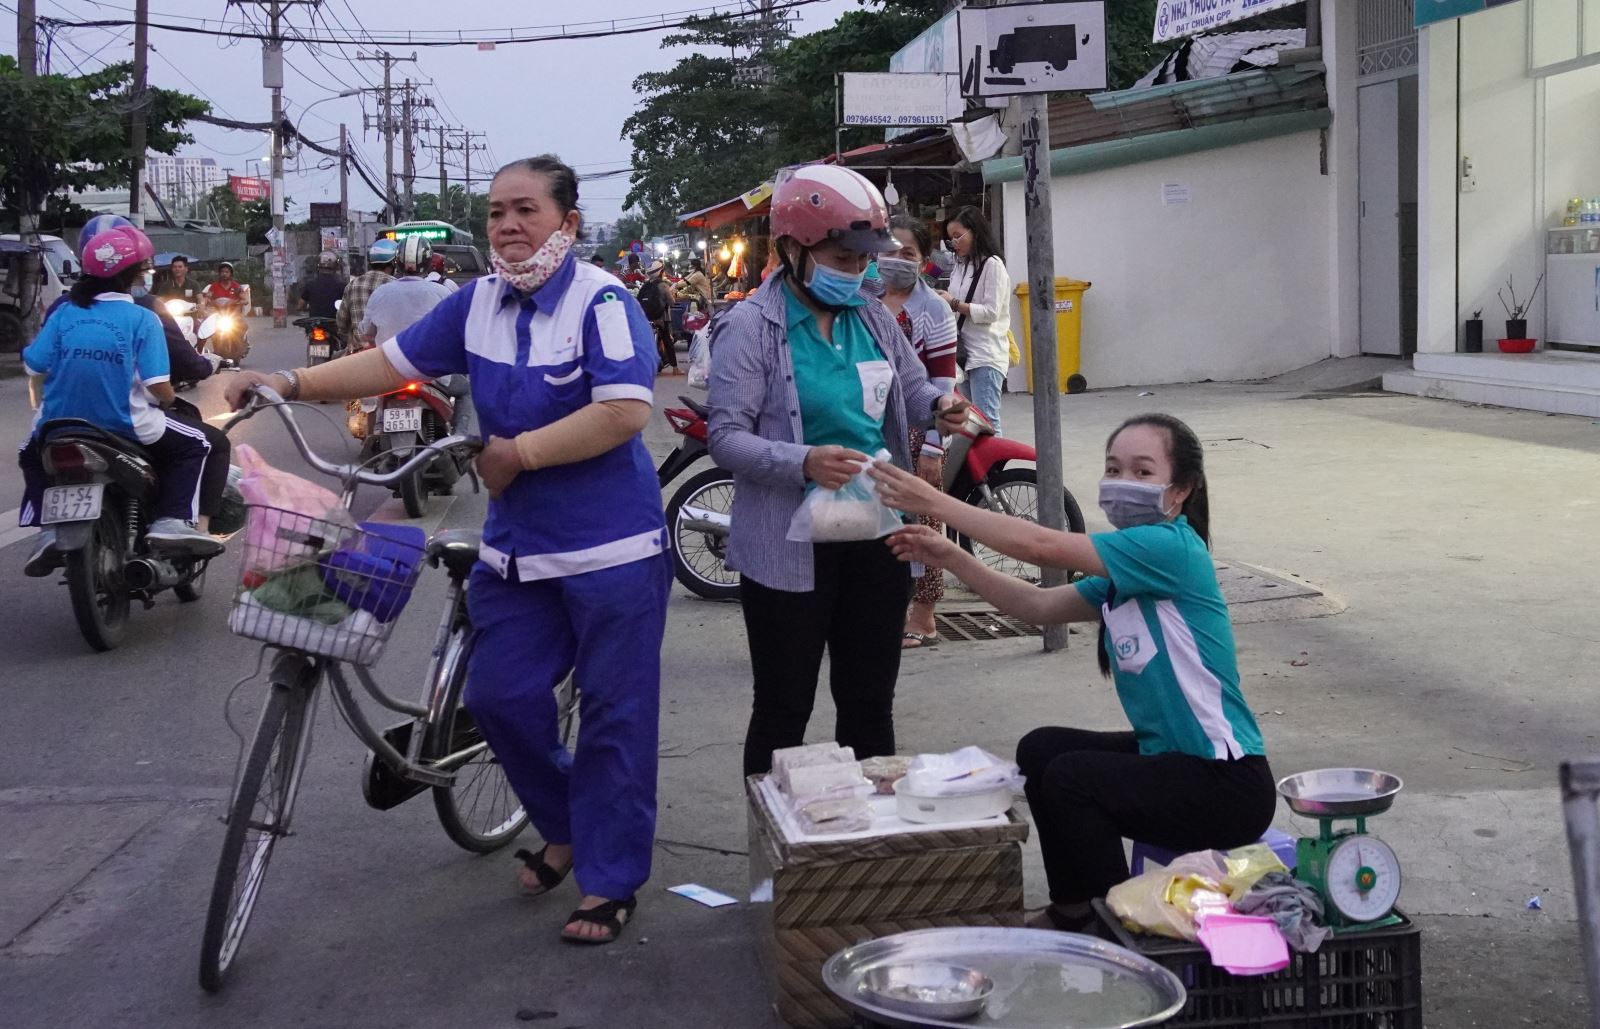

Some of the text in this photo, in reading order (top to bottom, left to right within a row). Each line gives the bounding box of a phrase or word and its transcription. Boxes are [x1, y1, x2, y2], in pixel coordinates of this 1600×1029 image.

[1217, 10, 1231, 21] GPP
[846, 114, 892, 123] 0979645542
[898, 115, 944, 124] 0979611513
[73, 348, 125, 365] PHONG
[49, 502, 92, 519] 9477
